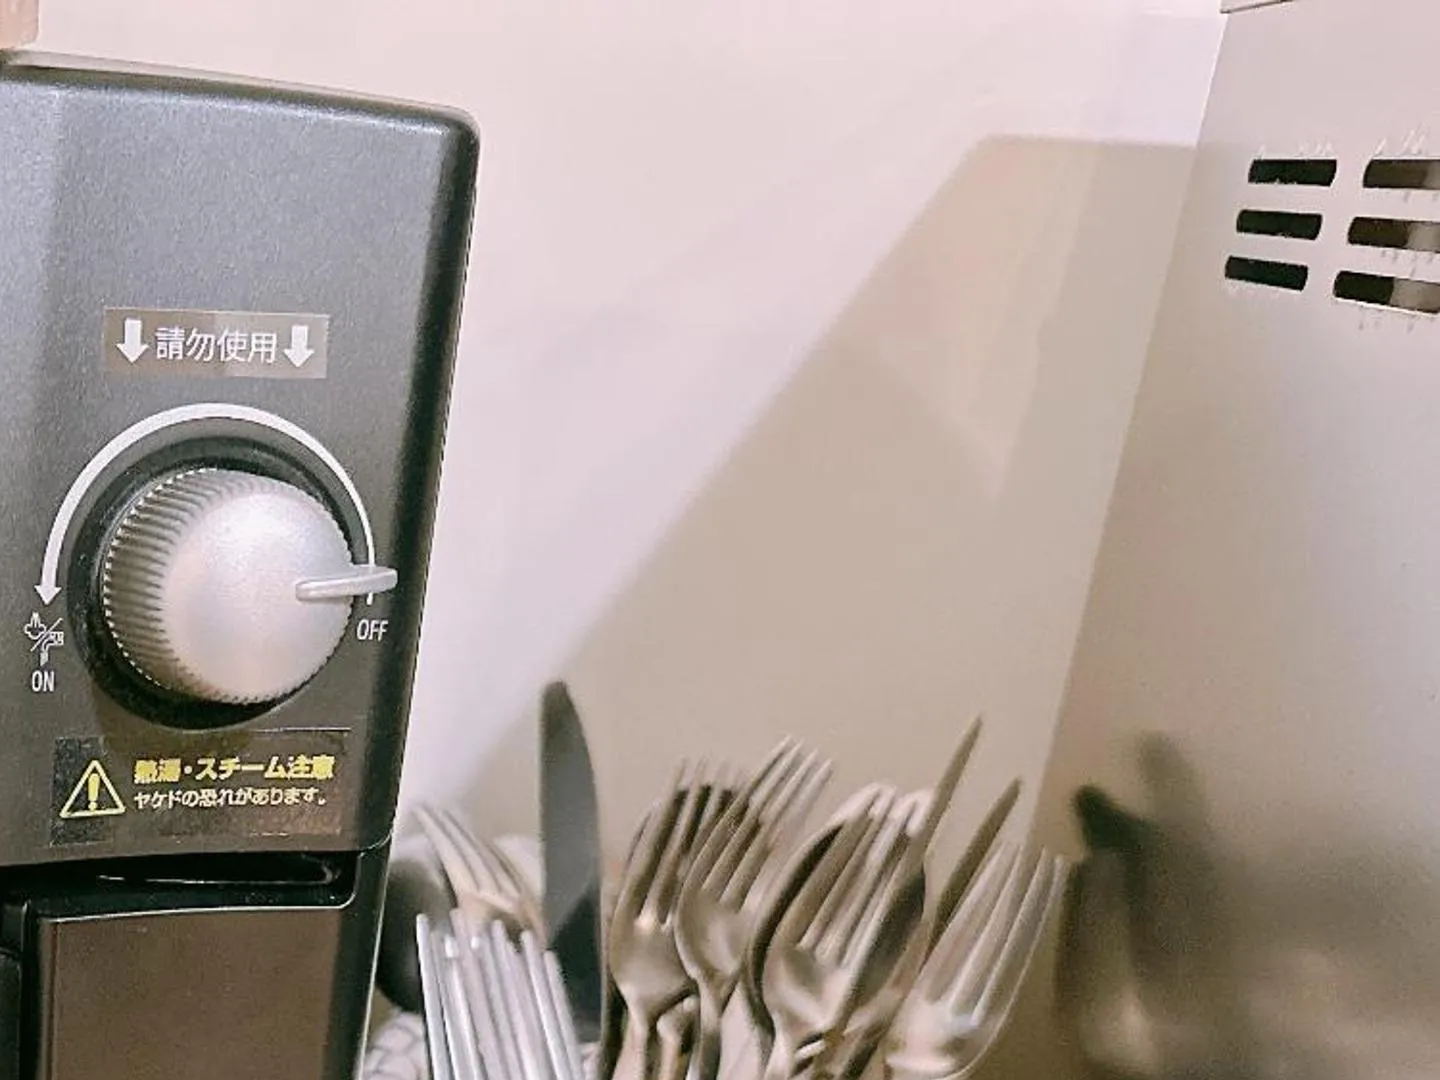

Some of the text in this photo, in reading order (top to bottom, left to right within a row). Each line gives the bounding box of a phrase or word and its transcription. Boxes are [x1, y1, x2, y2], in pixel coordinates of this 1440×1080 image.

[154, 326, 278, 364] 請勿使用
[356, 618, 389, 642] OFF
[31, 670, 55, 693] ON
